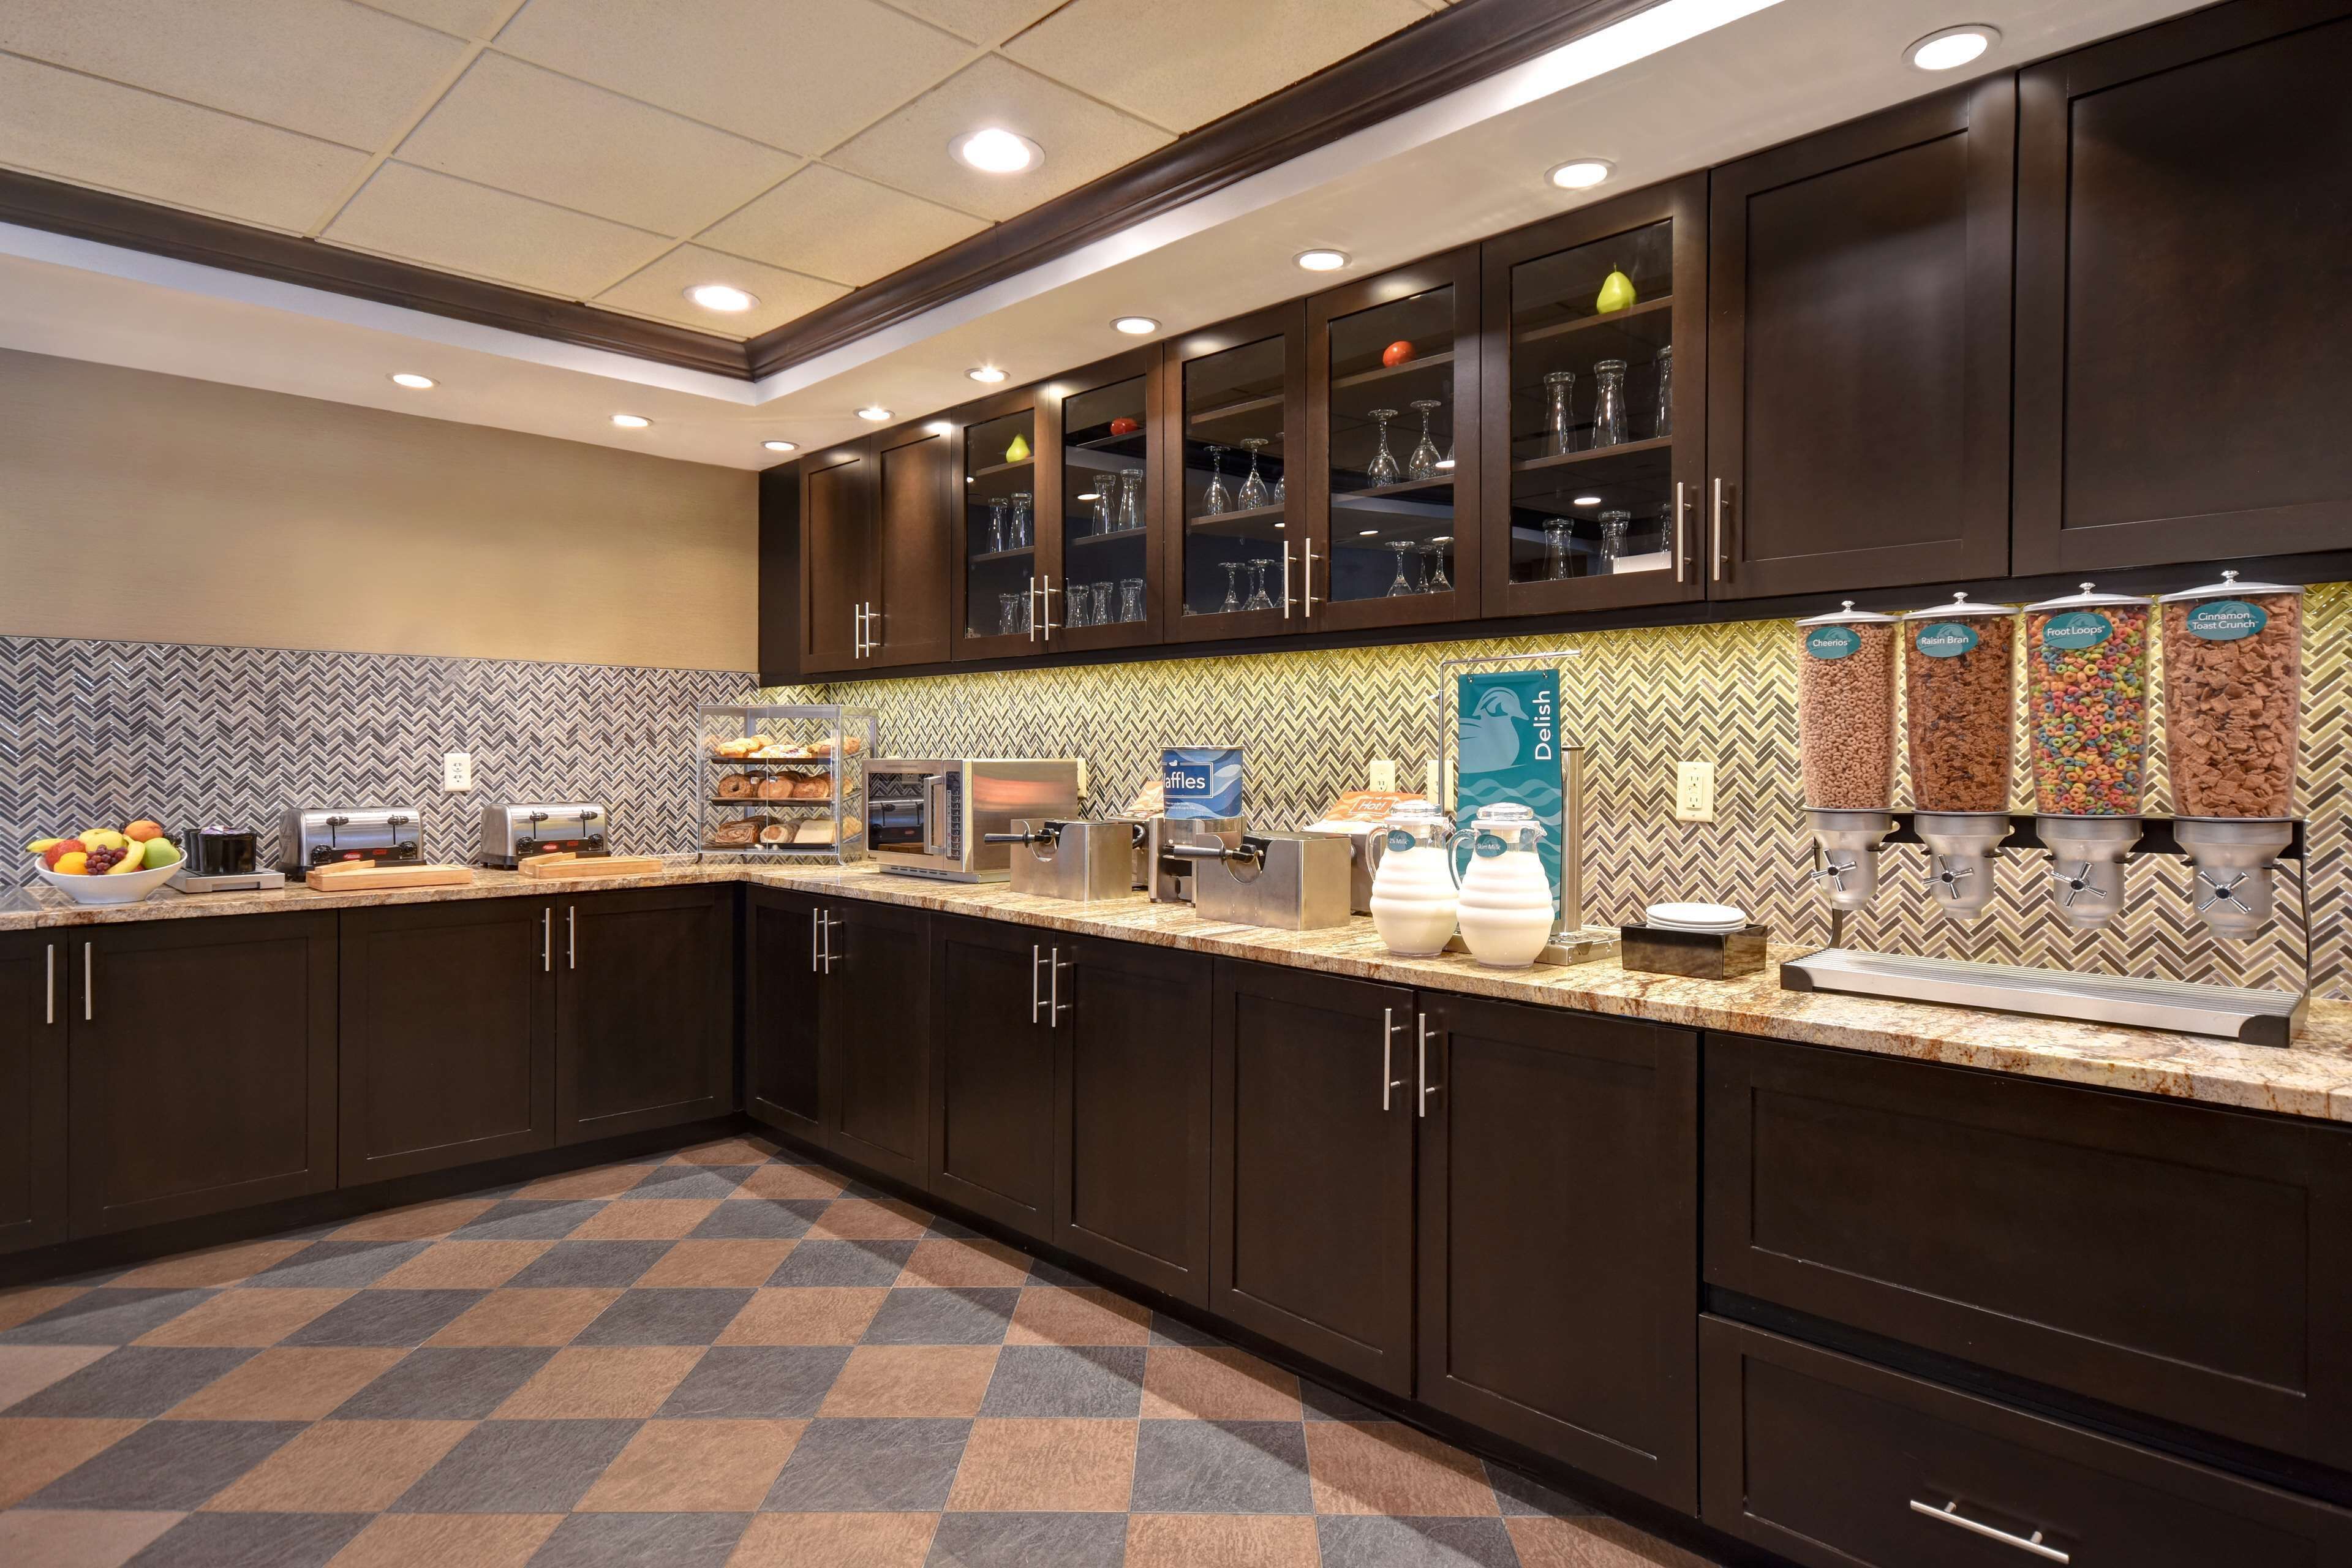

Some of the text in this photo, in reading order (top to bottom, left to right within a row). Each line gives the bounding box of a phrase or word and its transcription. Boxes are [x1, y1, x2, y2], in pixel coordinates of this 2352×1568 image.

[2218, 619, 2255, 628] Crunch
[2072, 627, 2103, 636] Loops
[1532, 690, 1551, 760] Delish
[1163, 771, 1205, 789] affles
[1358, 801, 1387, 810] Hot!
